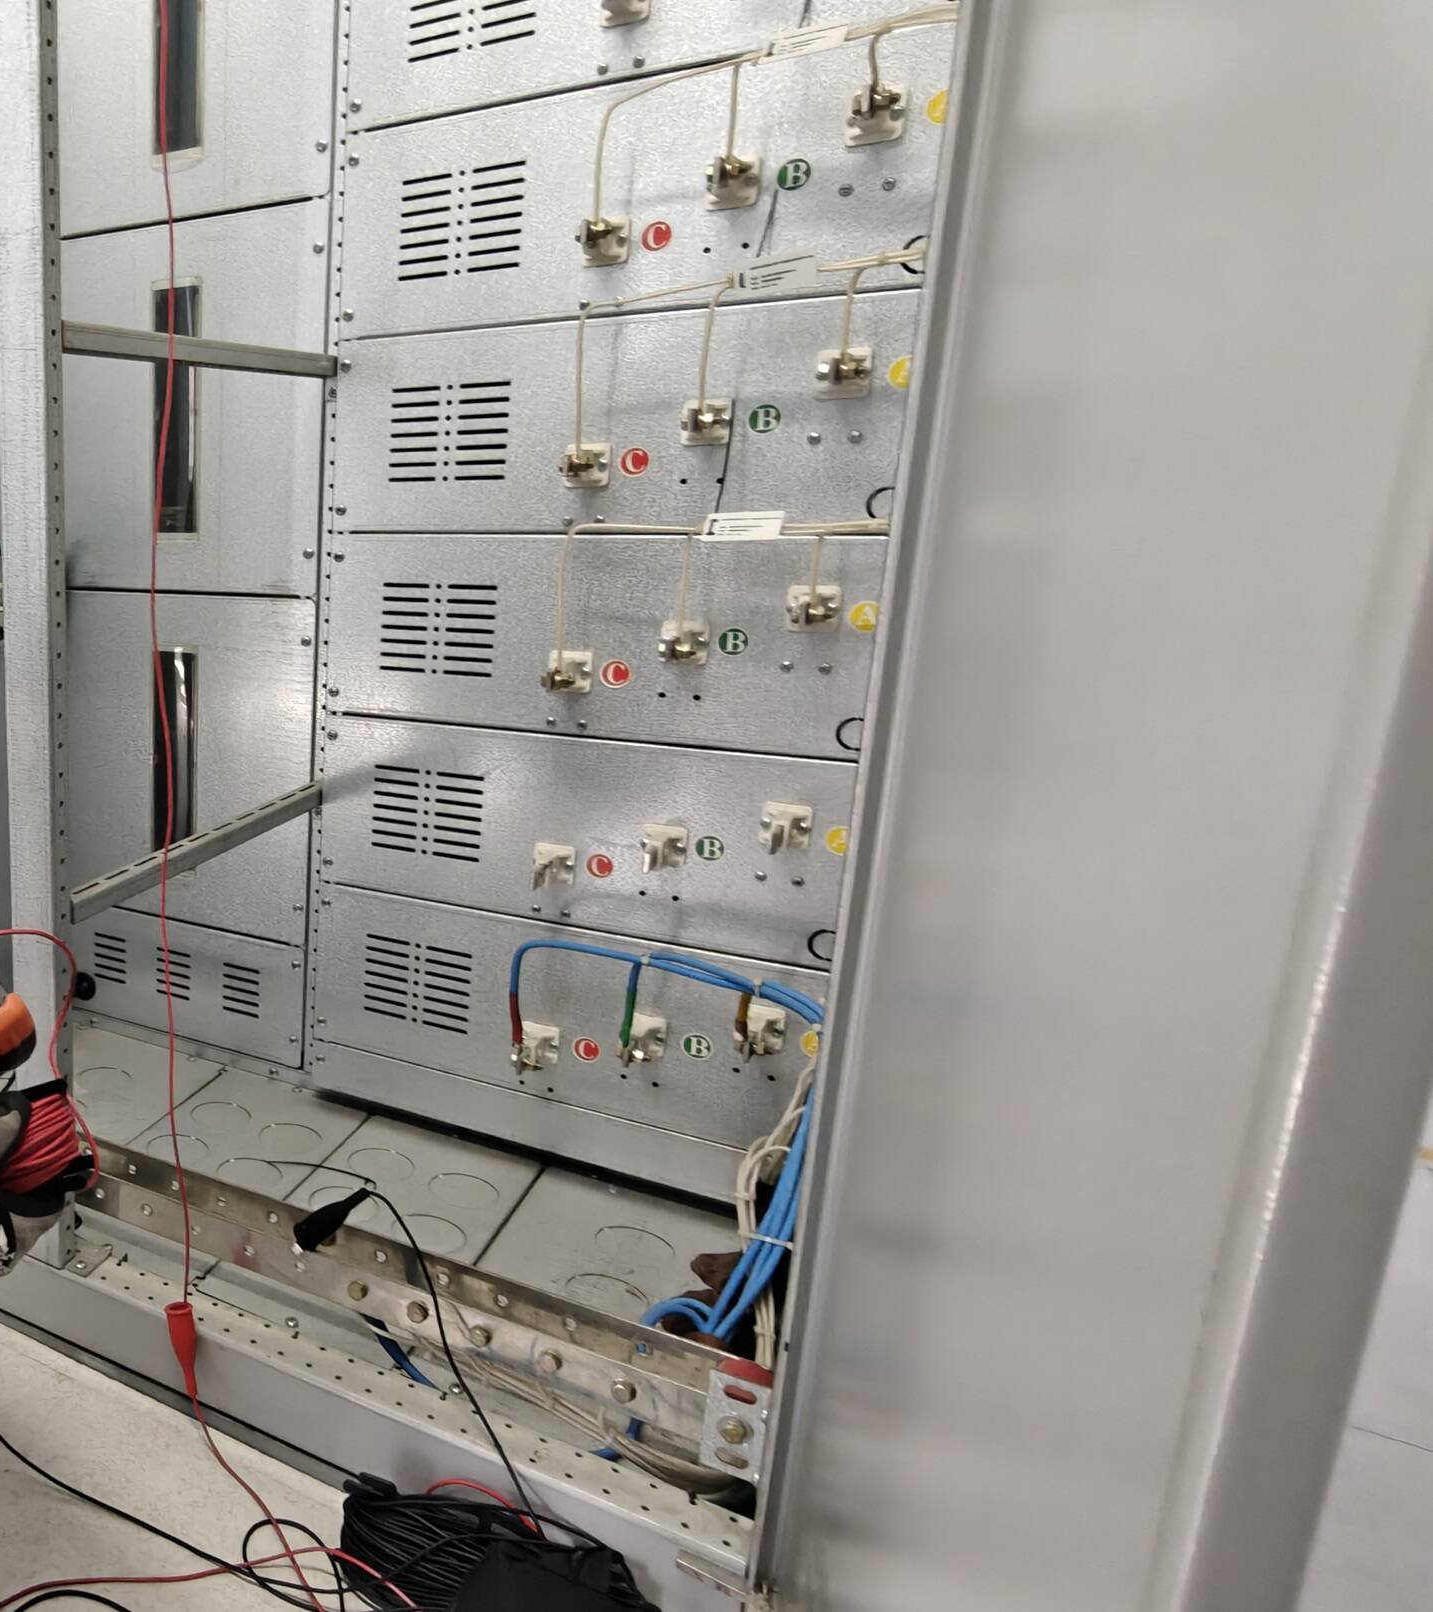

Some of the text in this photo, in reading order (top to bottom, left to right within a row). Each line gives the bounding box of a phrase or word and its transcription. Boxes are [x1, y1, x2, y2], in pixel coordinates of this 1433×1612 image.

[785, 162, 808, 188] B
[646, 223, 667, 249] C
[755, 407, 778, 432] B
[625, 449, 646, 473] C
[853, 604, 877, 625] A
[724, 630, 746, 653] B
[606, 662, 626, 685] C
[701, 837, 722, 859] B
[590, 855, 609, 878] C
[577, 1038, 597, 1061] C
[688, 1036, 710, 1058] B
